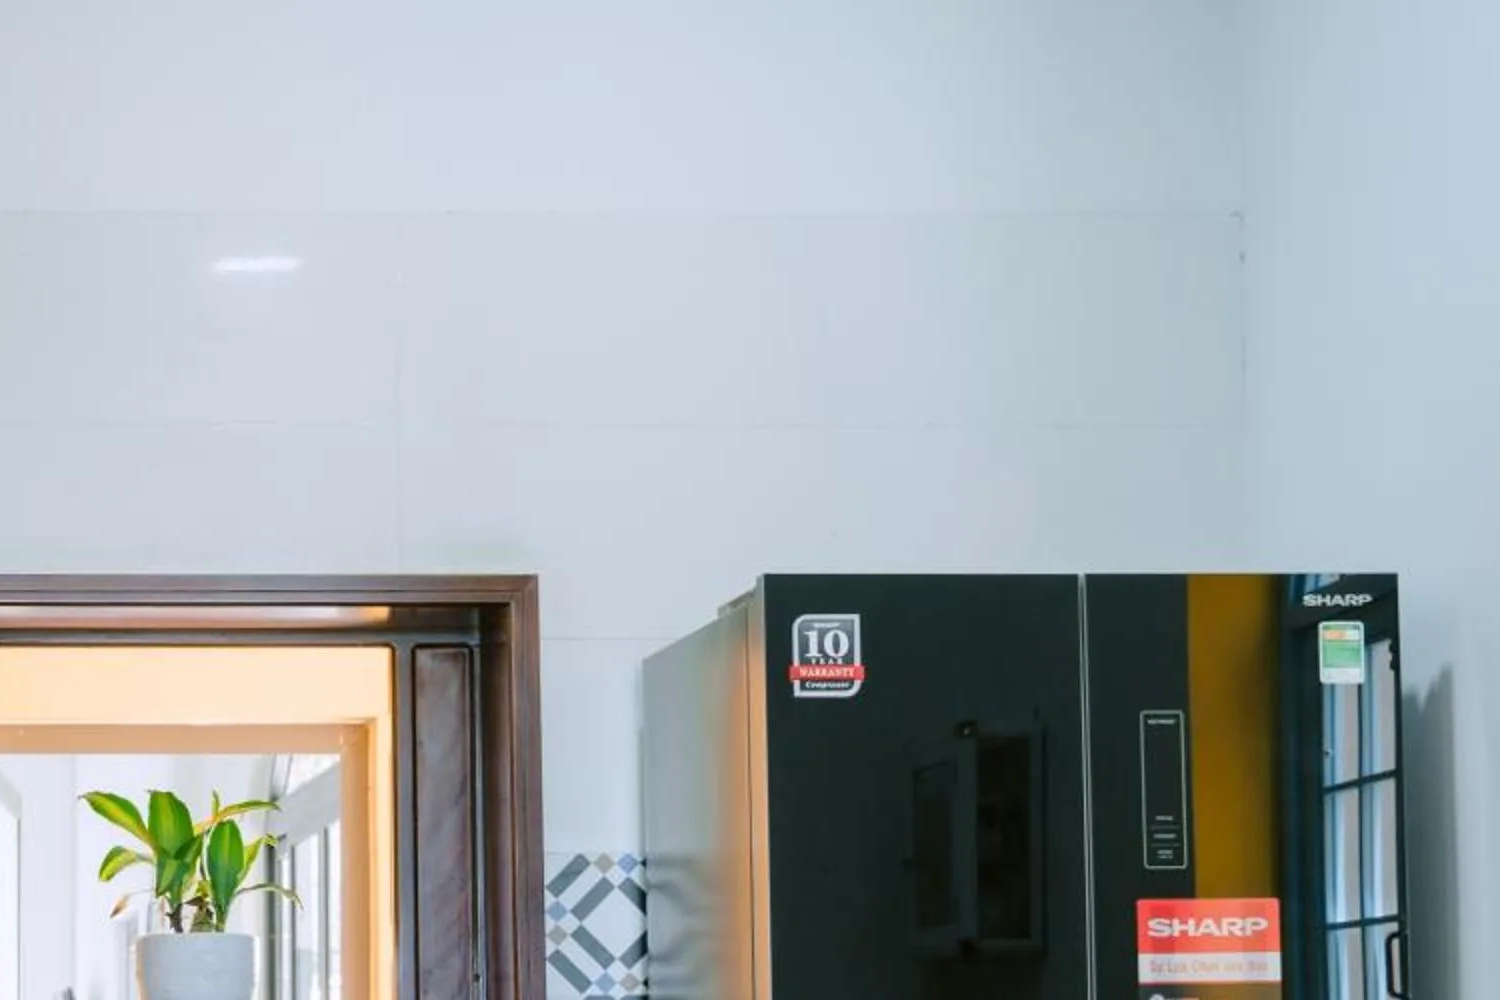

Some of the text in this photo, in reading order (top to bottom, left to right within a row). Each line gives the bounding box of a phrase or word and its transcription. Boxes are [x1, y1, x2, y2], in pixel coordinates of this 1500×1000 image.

[1302, 593, 1373, 607] SHARP
[803, 629, 849, 658] 10
[799, 667, 855, 678] WARRANTY
[1147, 916, 1269, 938] SHARP
